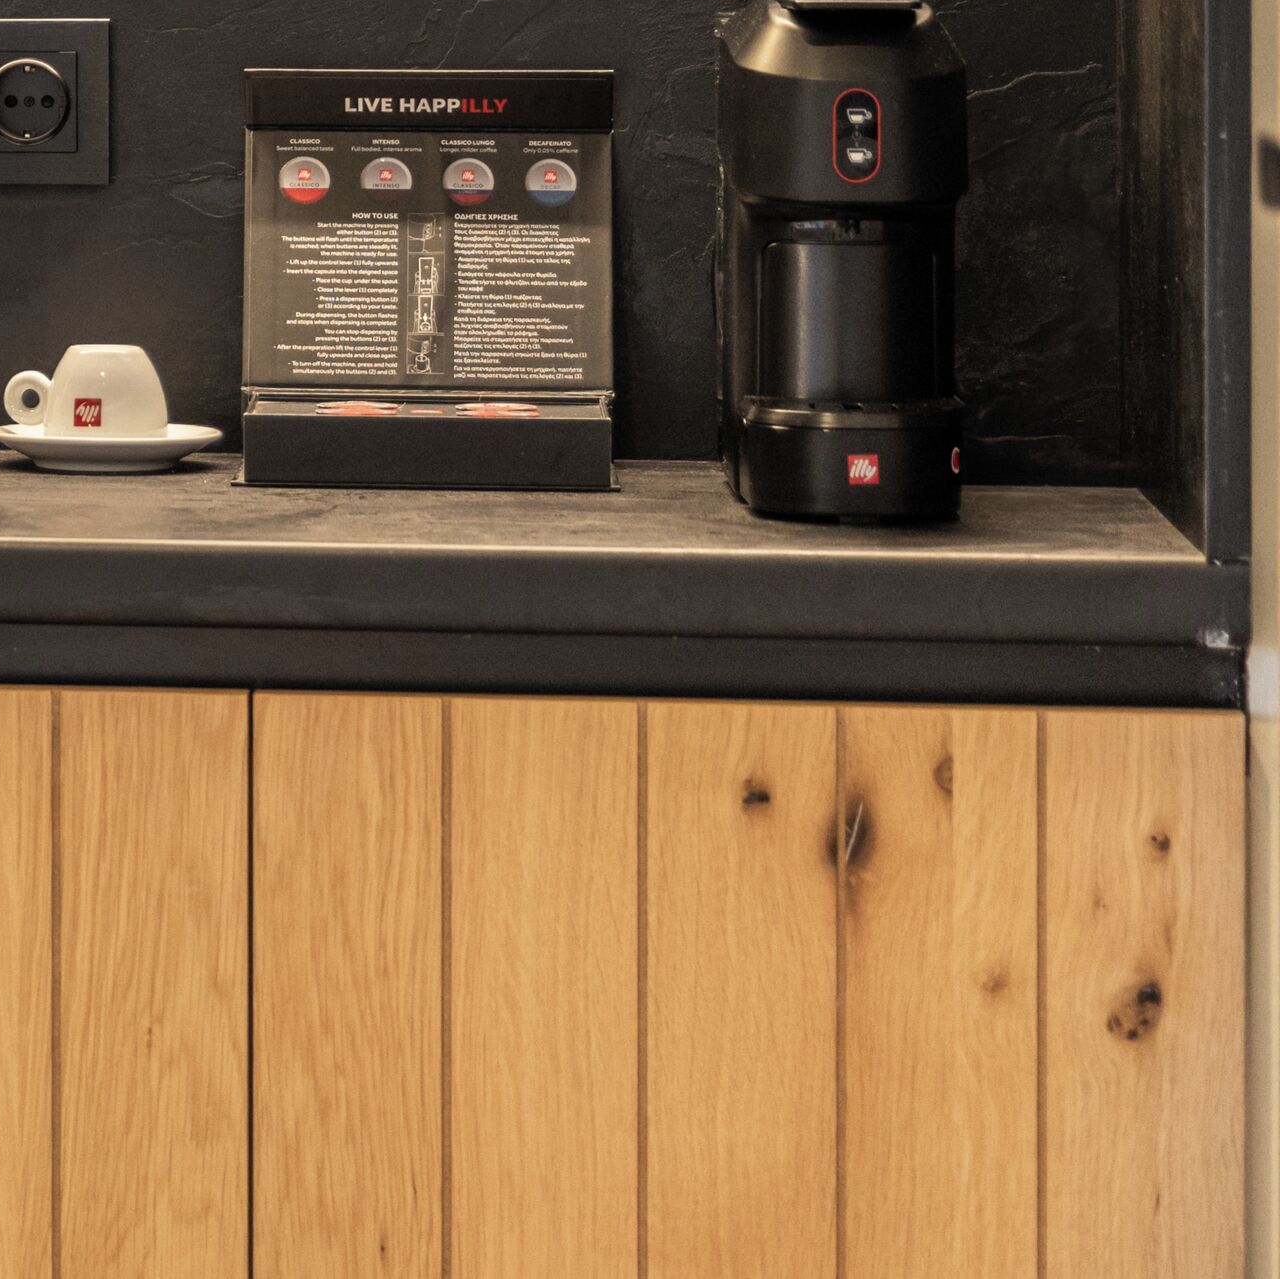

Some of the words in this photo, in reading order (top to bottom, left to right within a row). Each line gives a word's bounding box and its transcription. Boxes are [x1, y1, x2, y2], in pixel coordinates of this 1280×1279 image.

[344, 97, 393, 112] LIVE
[399, 98, 508, 113] HAPPILLY
[76, 401, 99, 422] illy
[850, 459, 876, 482] illy
